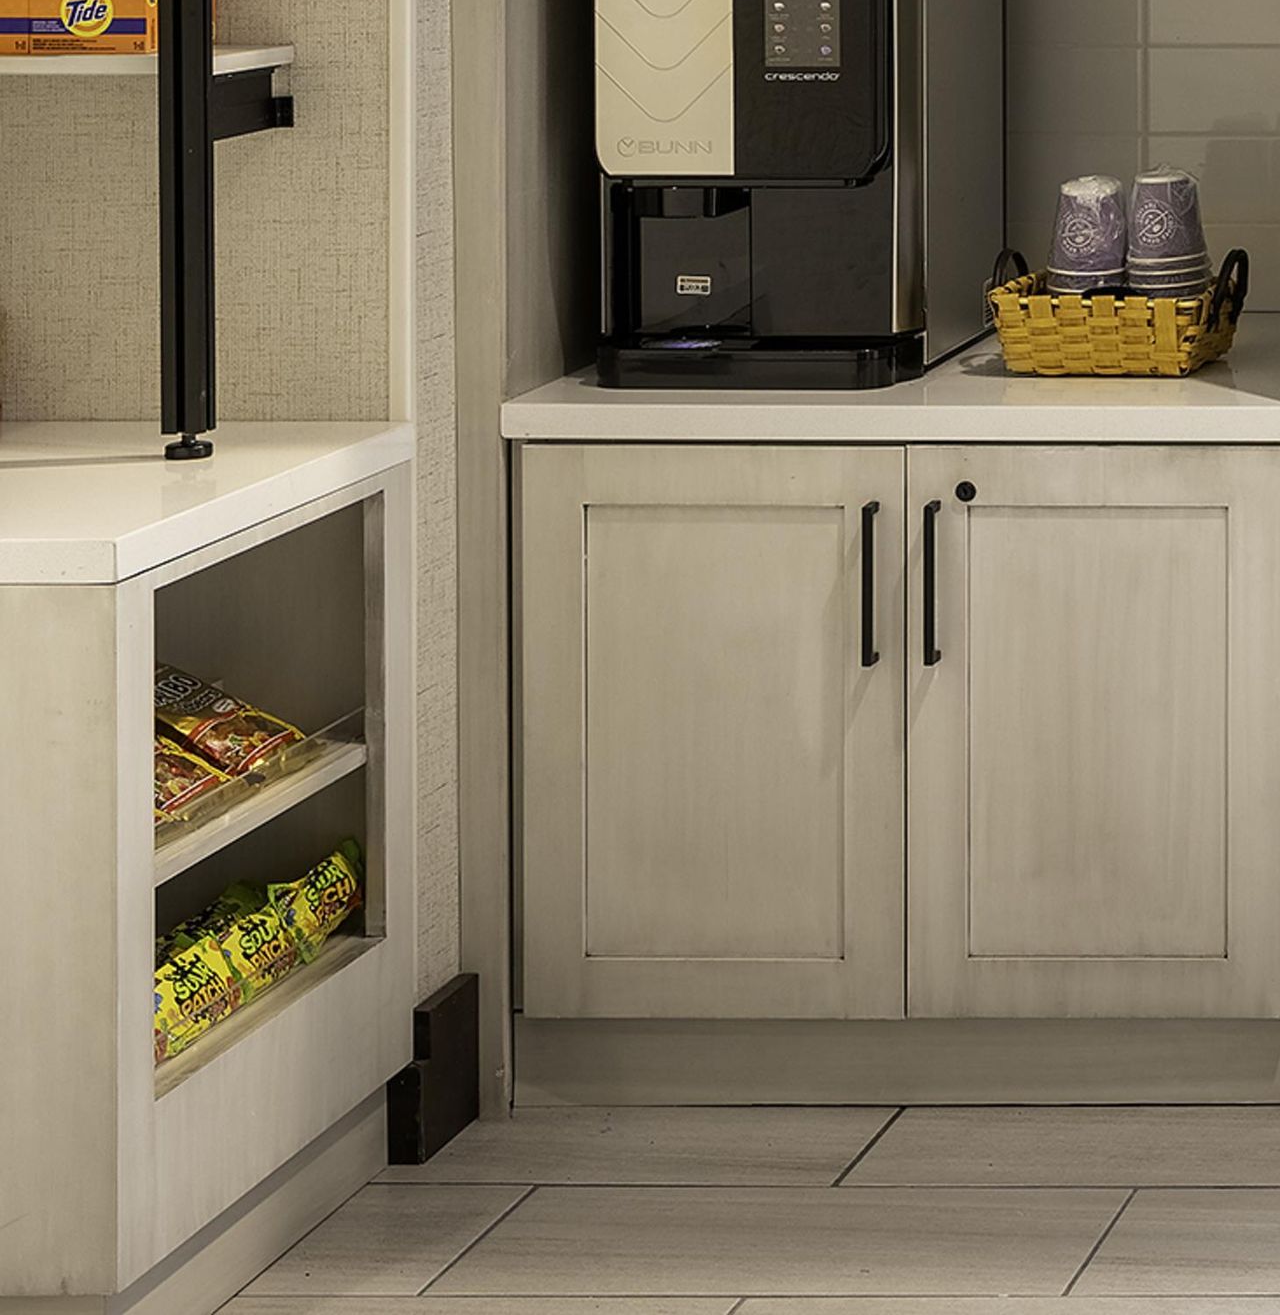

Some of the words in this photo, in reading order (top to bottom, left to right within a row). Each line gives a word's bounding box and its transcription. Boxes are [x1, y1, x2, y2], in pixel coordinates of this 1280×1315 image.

[66, 0, 107, 27] Tide
[764, 71, 840, 81] crescendo
[639, 140, 712, 155] BUNN
[172, 961, 214, 1001] SOUR
[181, 973, 226, 1017] PATCH
